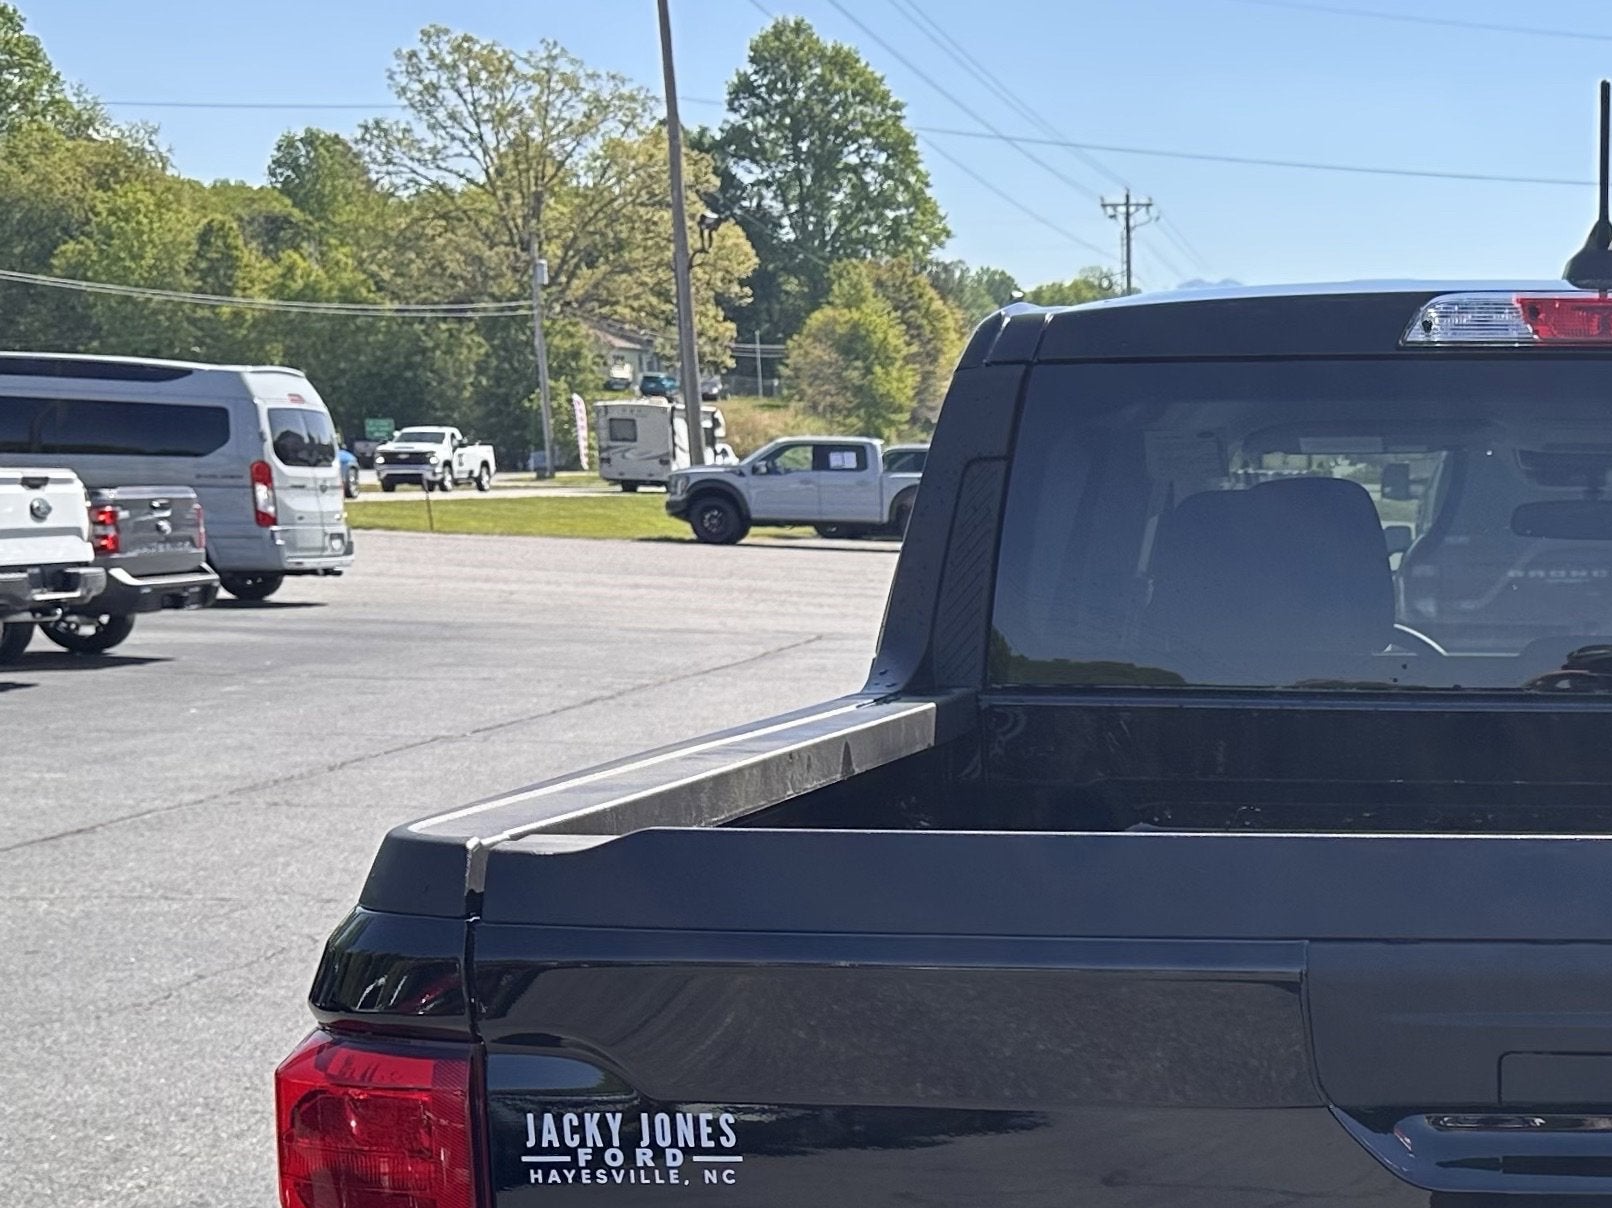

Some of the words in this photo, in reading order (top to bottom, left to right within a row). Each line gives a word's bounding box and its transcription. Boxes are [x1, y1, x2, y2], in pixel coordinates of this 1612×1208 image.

[526, 1112, 622, 1148] JACKY
[640, 1112, 736, 1148] JONES
[577, 1148, 685, 1167] FORD
[529, 1169, 690, 1186] HAYESVILLE,
[703, 1169, 736, 1185] NC
